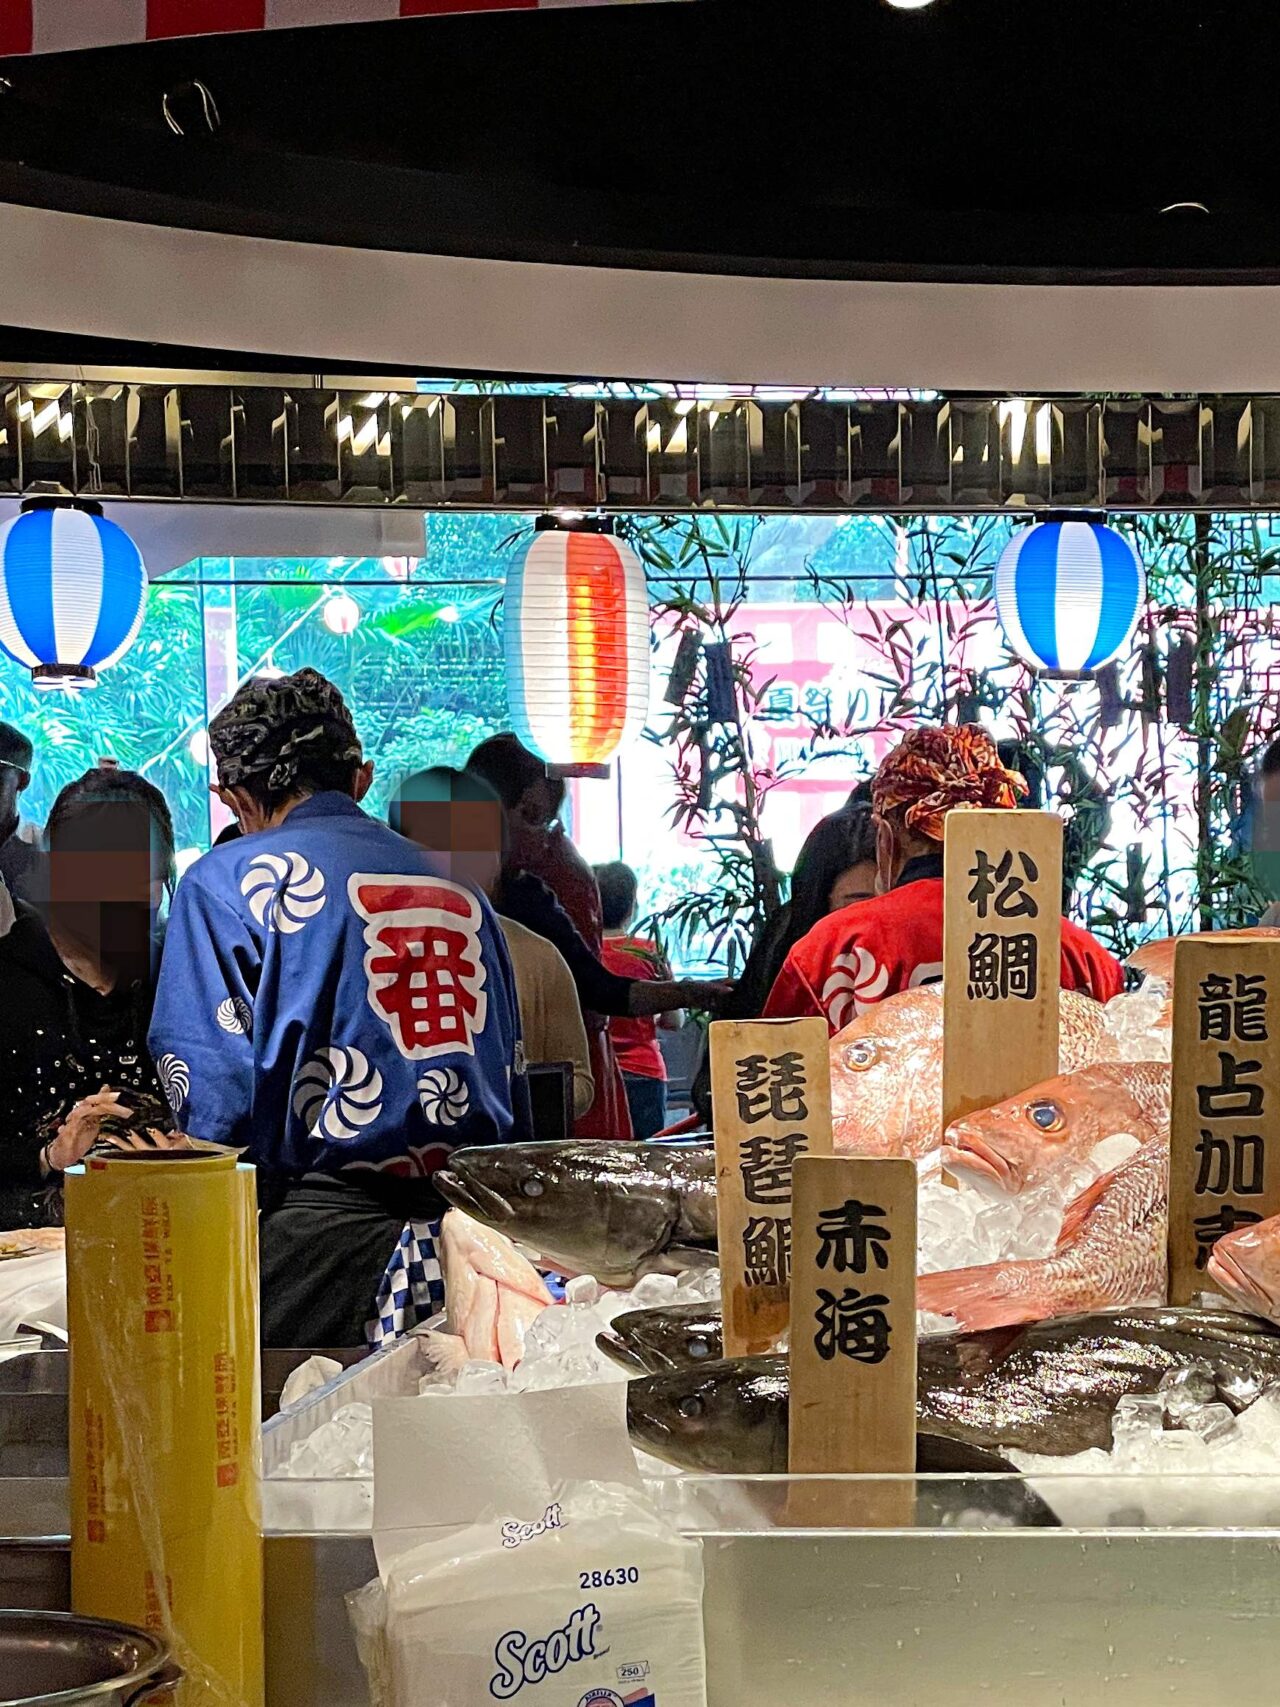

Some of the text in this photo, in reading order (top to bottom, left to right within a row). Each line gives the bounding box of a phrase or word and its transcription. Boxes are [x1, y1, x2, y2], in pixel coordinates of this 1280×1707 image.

[356, 883, 479, 1051] 一番
[967, 850, 1038, 1000] 松鯛
[814, 1200, 892, 1365] 赤海
[501, 1503, 562, 1548] Scott
[579, 1567, 639, 1589] 28630
[490, 1603, 600, 1699] Scott
[620, 1667, 639, 1677] 250
